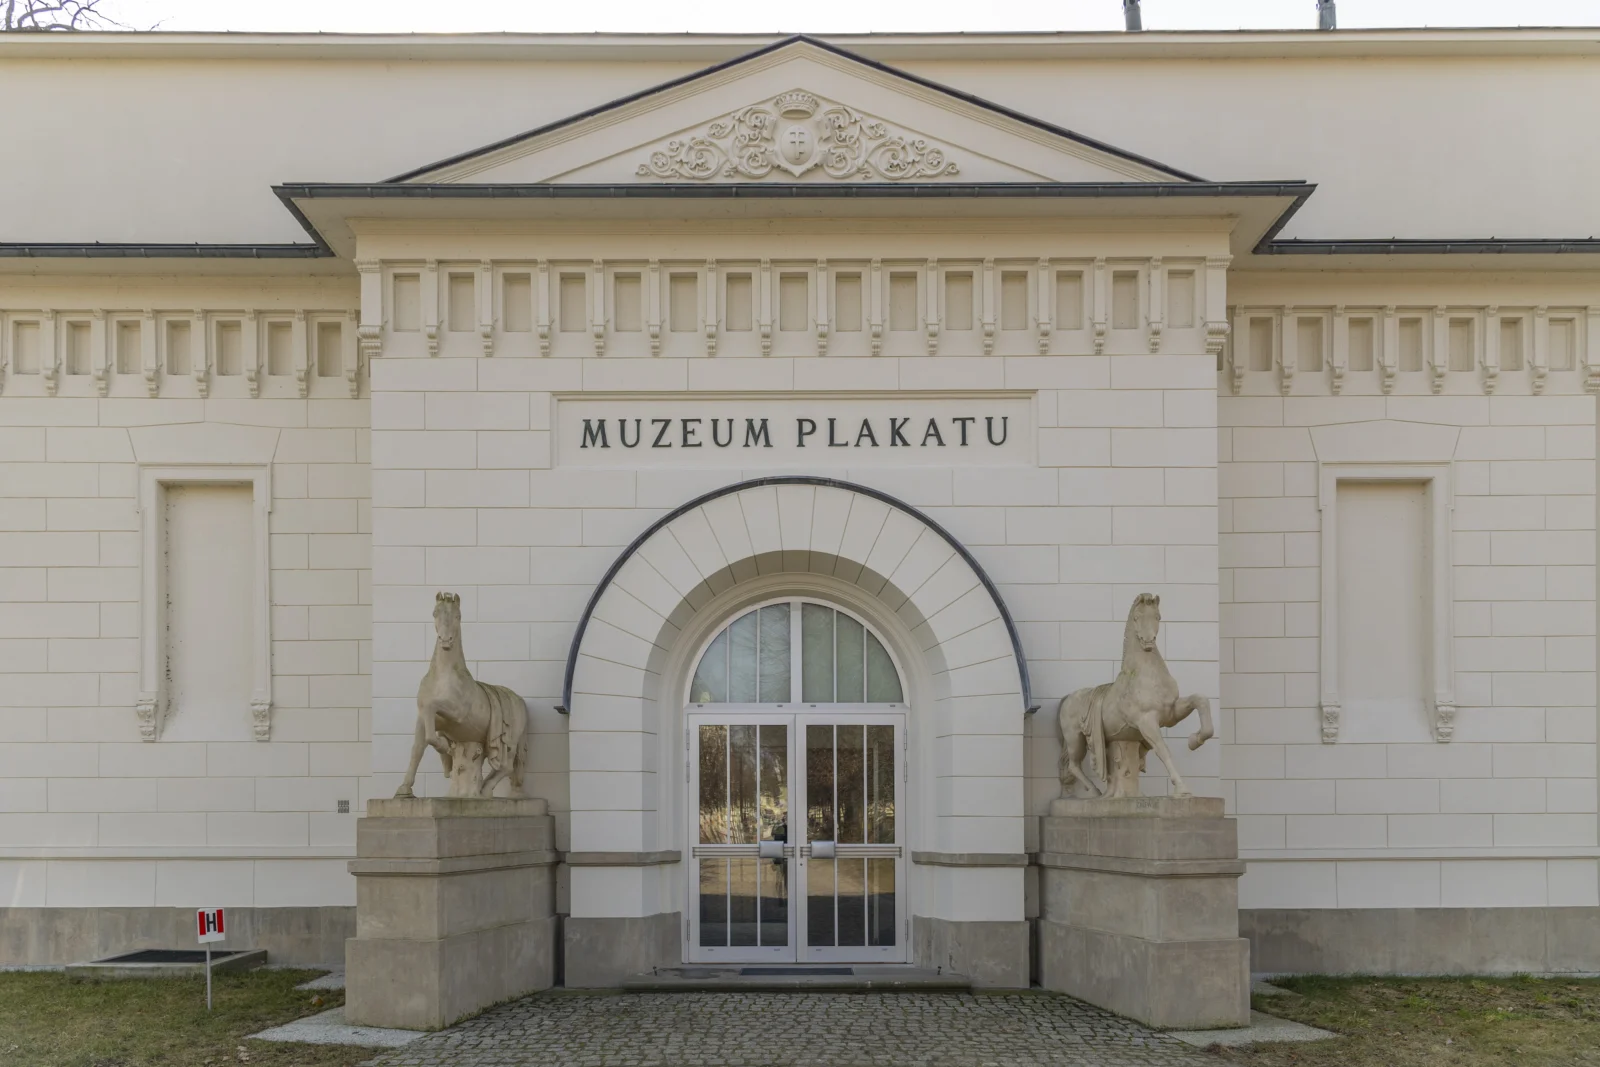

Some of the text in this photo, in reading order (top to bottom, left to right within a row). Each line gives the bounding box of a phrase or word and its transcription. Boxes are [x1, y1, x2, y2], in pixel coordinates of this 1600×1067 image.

[580, 416, 1009, 448] MUZEUM PLAKATU
[206, 913, 217, 932] H
